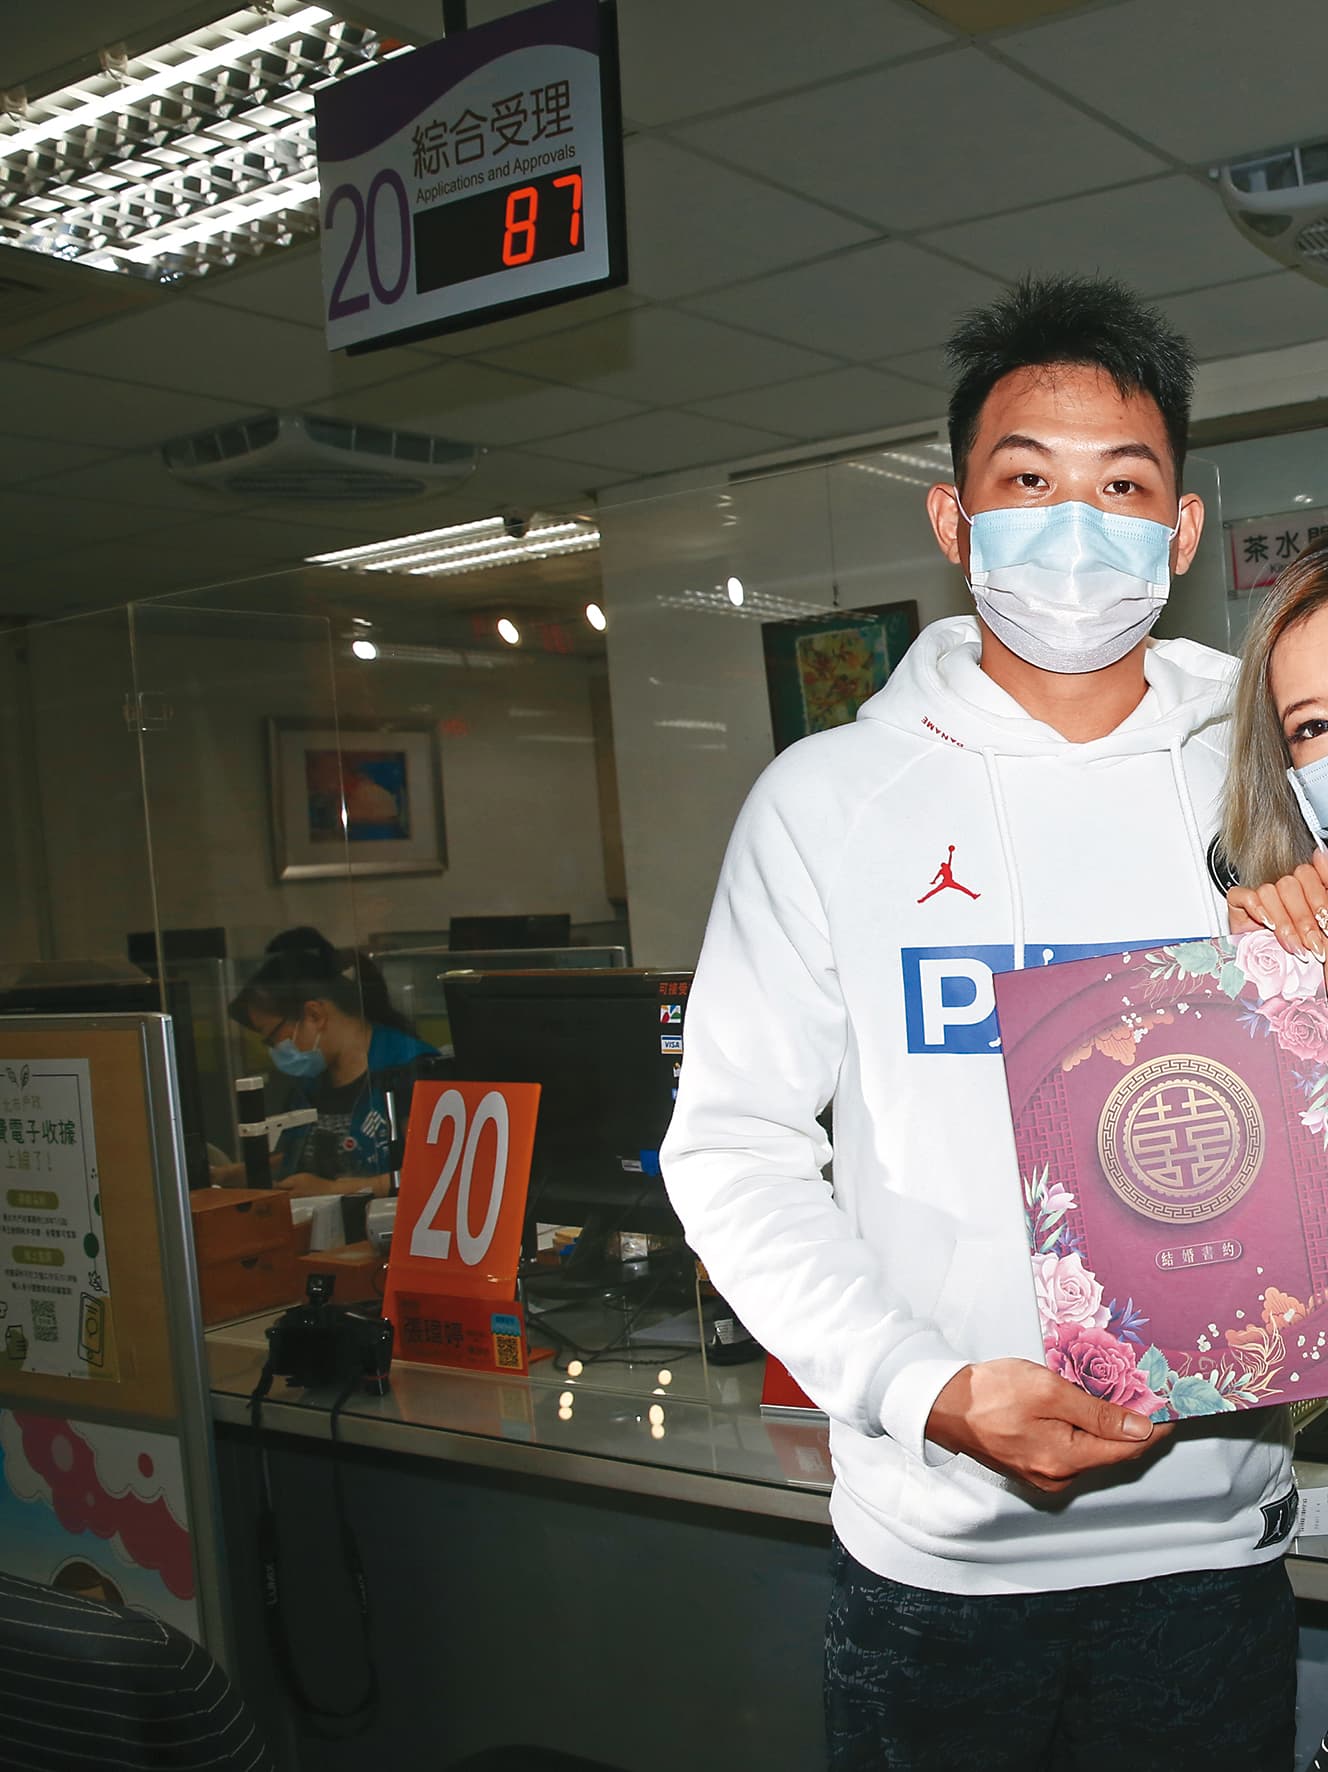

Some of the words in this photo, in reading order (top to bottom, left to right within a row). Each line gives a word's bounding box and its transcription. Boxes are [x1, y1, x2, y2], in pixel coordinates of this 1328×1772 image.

[411, 79, 574, 179] 綜合受理
[416, 173, 484, 204] Applications
[487, 163, 511, 181] and
[513, 143, 576, 175] Approvals
[324, 168, 412, 321] 20
[502, 173, 583, 266] 87
[920, 715, 965, 748] PANAME
[664, 1040, 680, 1049] VISA
[409, 1088, 510, 1266] 20
[1160, 1241, 1235, 1267] 結婚書約
